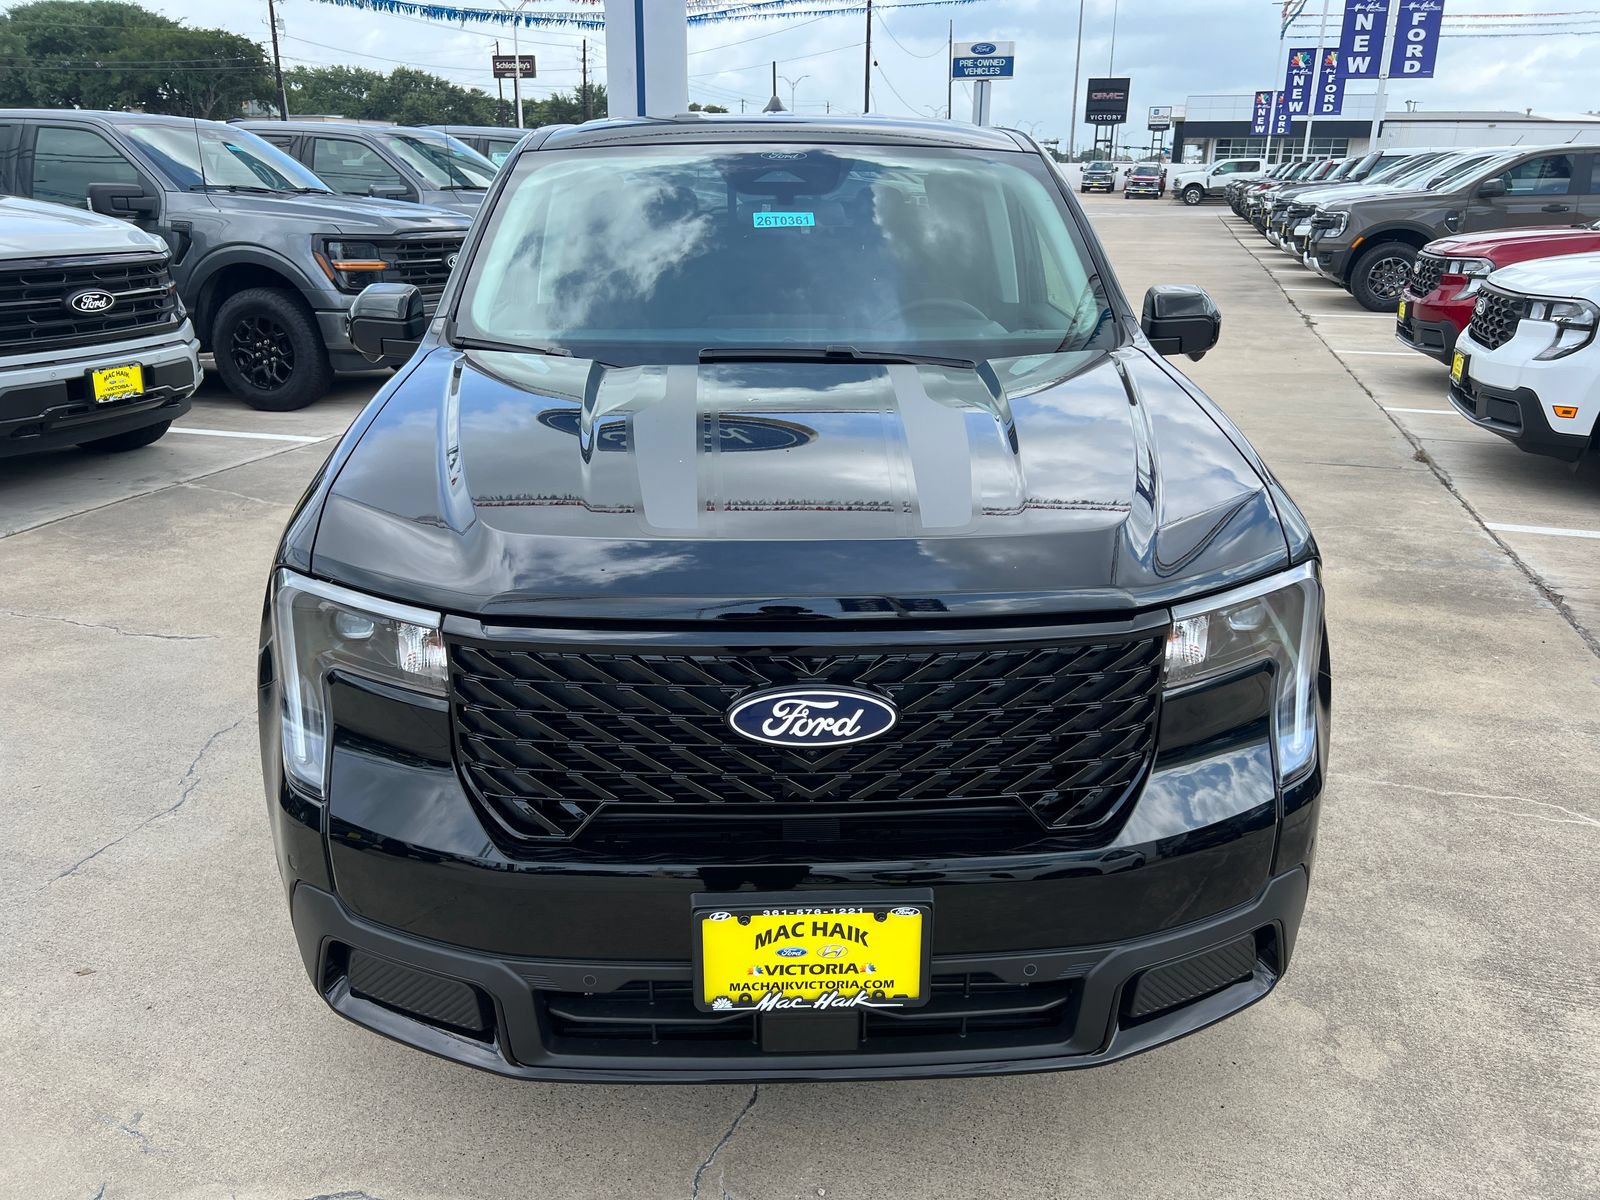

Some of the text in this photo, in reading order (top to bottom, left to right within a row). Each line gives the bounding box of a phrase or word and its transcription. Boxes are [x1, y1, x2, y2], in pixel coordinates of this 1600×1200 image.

[1347, 13, 1374, 74] NEW
[1403, 12, 1427, 74] FORD
[959, 58, 1006, 67] PRE-OWNED
[964, 66, 1001, 75] VEHICLES
[1092, 92, 1124, 100] GMC
[1288, 75, 1305, 113] NEW
[1322, 75, 1337, 113] FORD
[1255, 108, 1266, 133] NEW
[1277, 109, 1287, 134] ORD
[768, 152, 799, 160] Ford
[756, 215, 810, 226] 26T0361
[80, 294, 107, 310] Ford
[761, 699, 865, 738] Ford
[762, 907, 864, 916] 361-576-1221
[895, 907, 914, 916] Ford
[754, 921, 869, 950] MAC HAIK
[780, 948, 803, 957] Ford
[764, 962, 860, 976] VICTORIA
[729, 979, 895, 992] MACHAIKVICTORIA.COM
[755, 990, 870, 1011] Mac Haik
